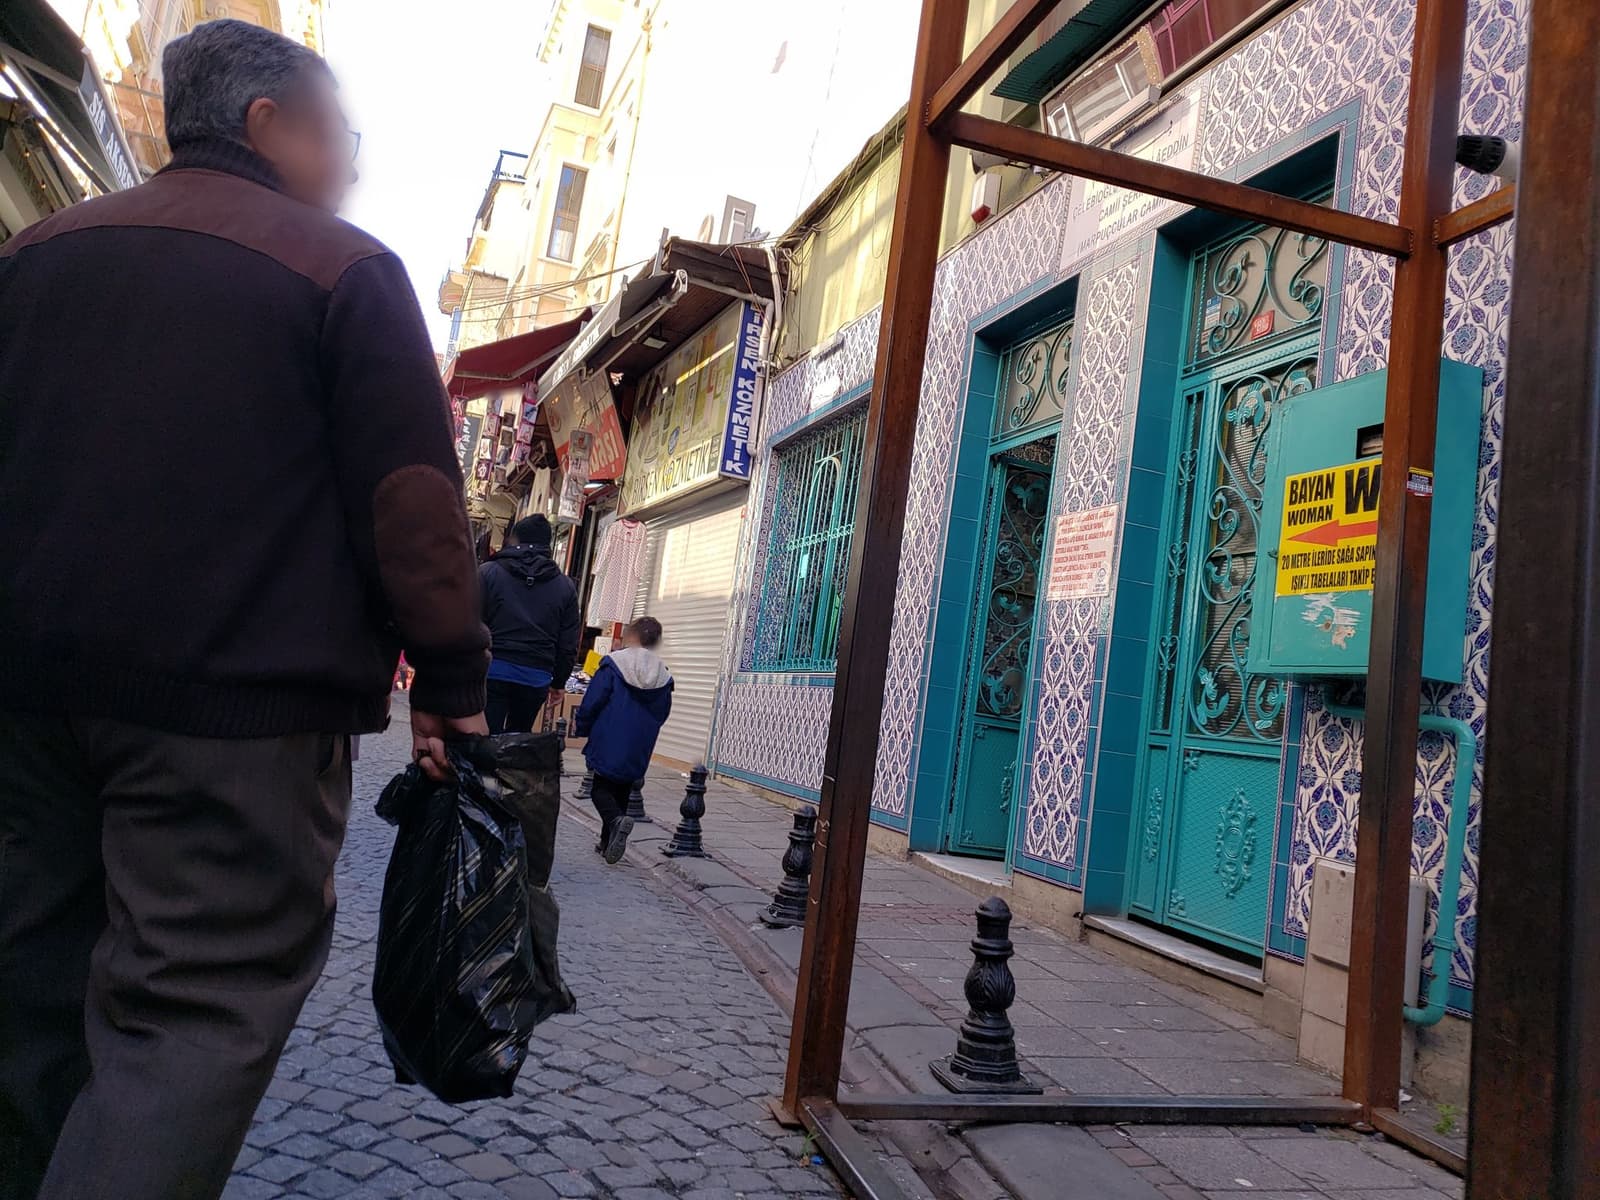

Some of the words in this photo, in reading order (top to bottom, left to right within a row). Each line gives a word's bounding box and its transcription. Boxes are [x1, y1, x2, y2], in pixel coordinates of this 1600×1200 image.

[1289, 472, 1336, 506] BAYAN
[1288, 504, 1333, 527] WOMAN
[1281, 555, 1290, 570] 20
[1291, 552, 1311, 569] METRE
[1311, 548, 1336, 567] İLERİDE
[1336, 545, 1355, 564] SAĞA
[1311, 569, 1348, 588] TABELALARI
[1350, 566, 1369, 585] TAKİP
